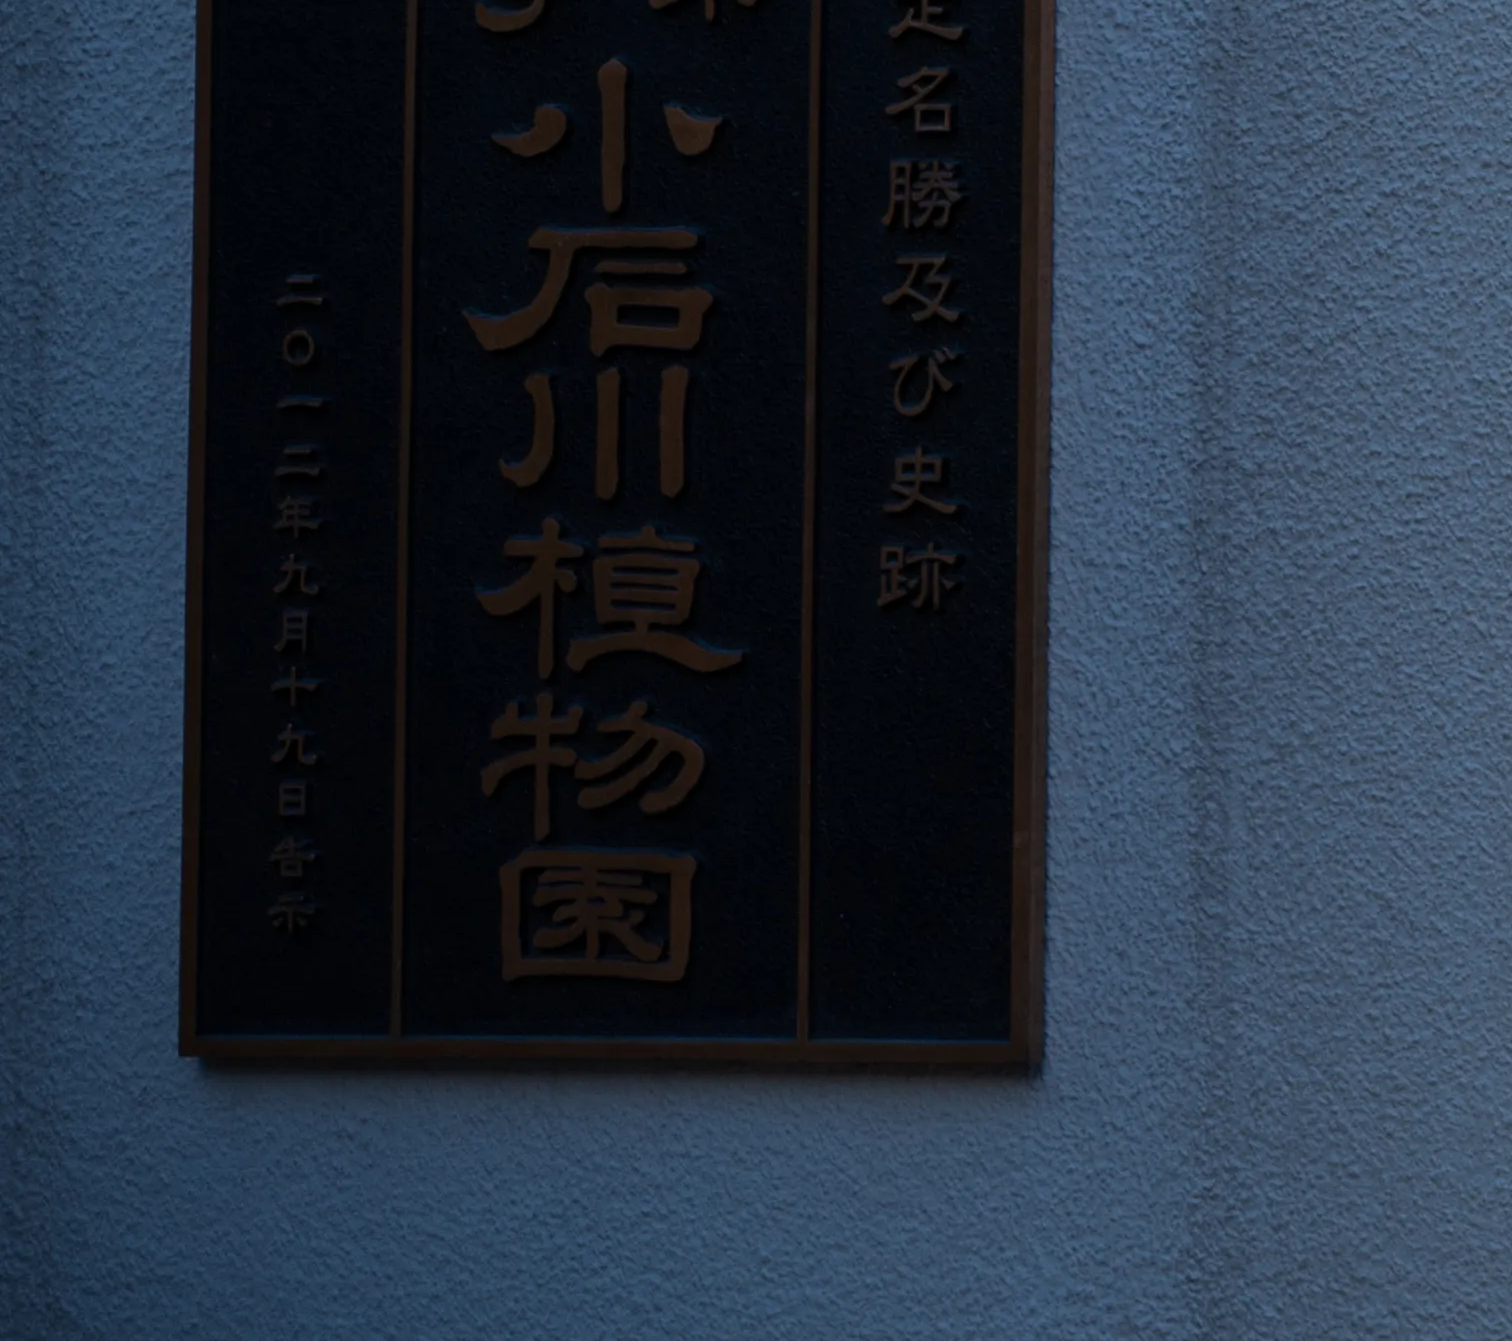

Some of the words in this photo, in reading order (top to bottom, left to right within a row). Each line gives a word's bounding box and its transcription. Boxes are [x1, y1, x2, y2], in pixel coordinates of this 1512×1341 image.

[462, 55, 746, 985] 小石川植物園
